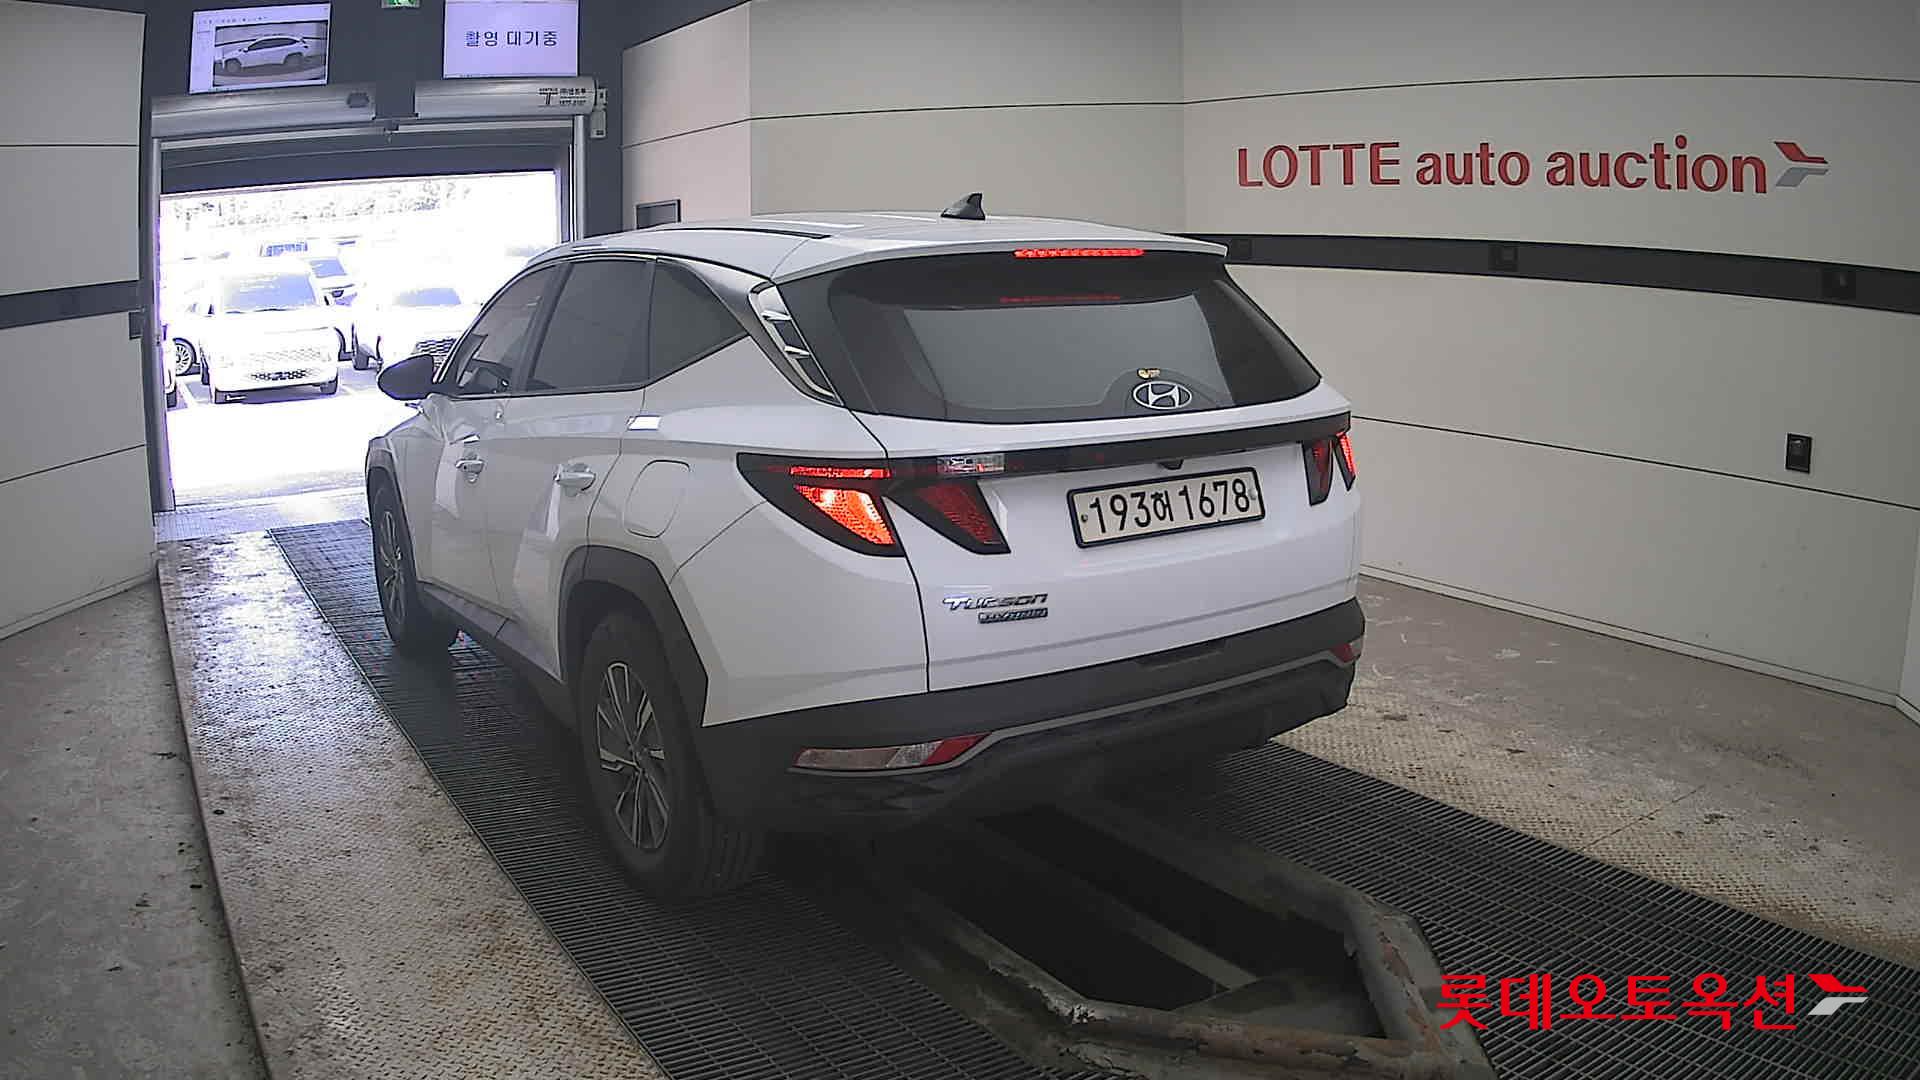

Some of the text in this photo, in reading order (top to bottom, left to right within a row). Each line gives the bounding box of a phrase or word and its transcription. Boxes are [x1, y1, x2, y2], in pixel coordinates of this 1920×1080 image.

[506, 31, 557, 47] 대기중
[1237, 135, 1767, 193] LOTTE auto auction
